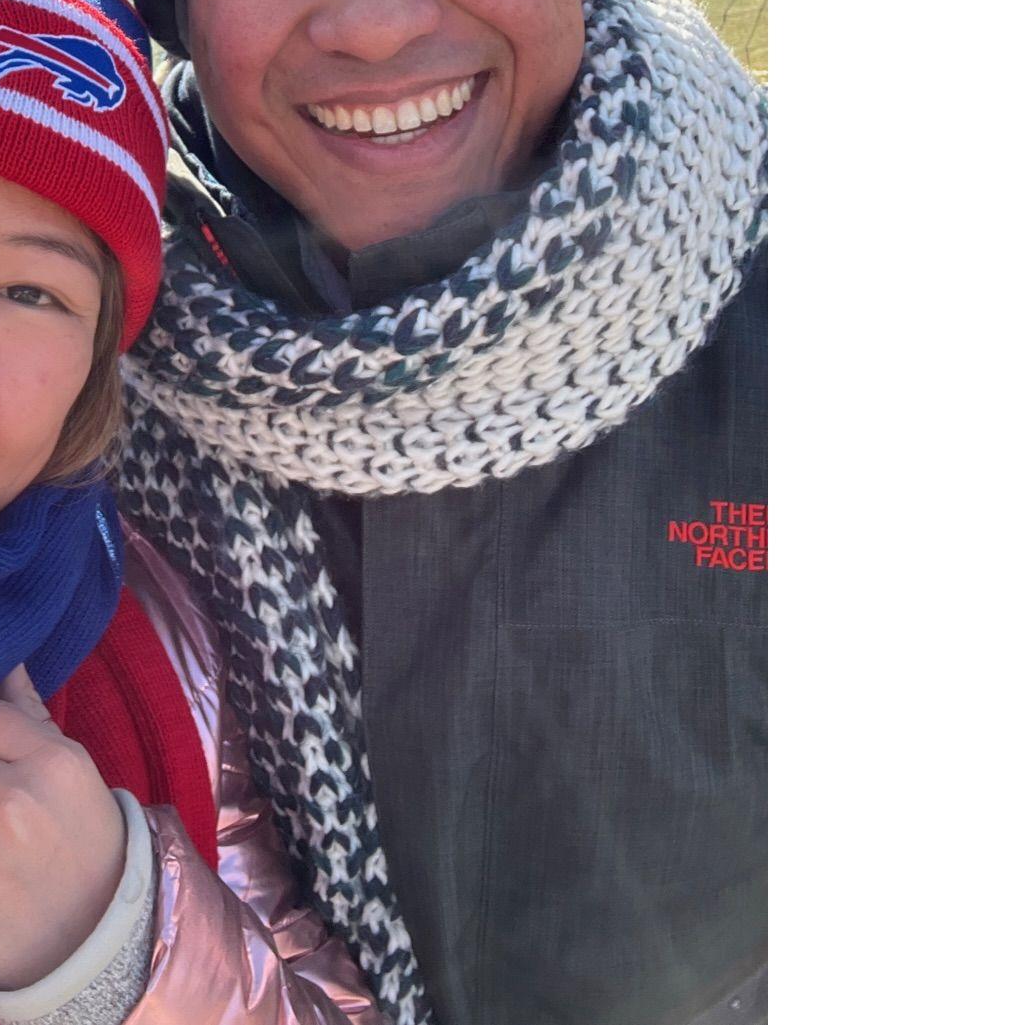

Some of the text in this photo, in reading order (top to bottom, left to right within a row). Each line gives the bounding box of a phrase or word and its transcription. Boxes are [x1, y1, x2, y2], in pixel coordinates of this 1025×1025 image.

[709, 501, 766, 526] THE
[668, 520, 766, 549] NORTH
[696, 545, 766, 571] FACE
